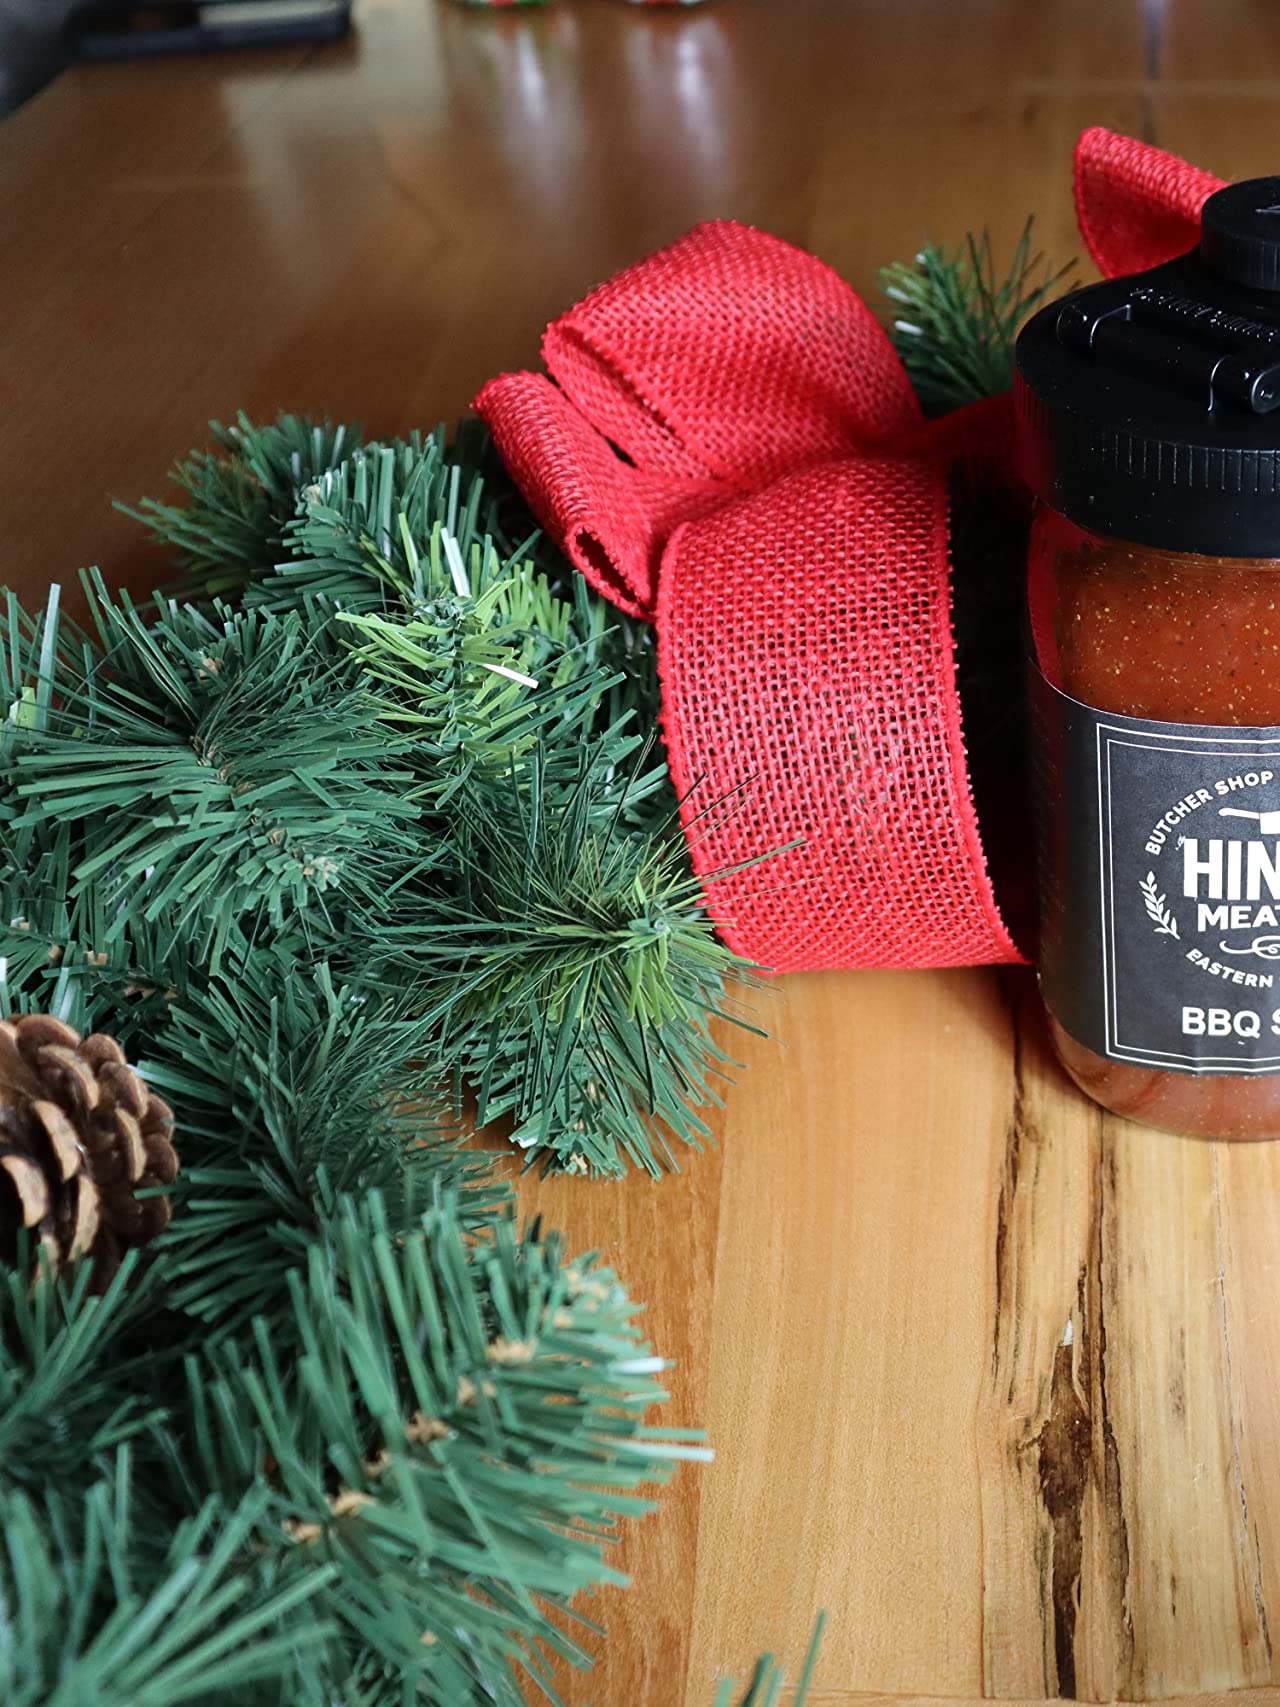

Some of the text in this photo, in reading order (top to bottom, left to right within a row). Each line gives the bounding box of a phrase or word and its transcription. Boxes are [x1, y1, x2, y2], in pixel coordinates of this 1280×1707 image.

[1145, 788, 1214, 856] BUTCHER
[1214, 771, 1274, 796] SHOP
[1186, 948, 1274, 988] EASTERN
[1182, 1006, 1261, 1039] BBQ
